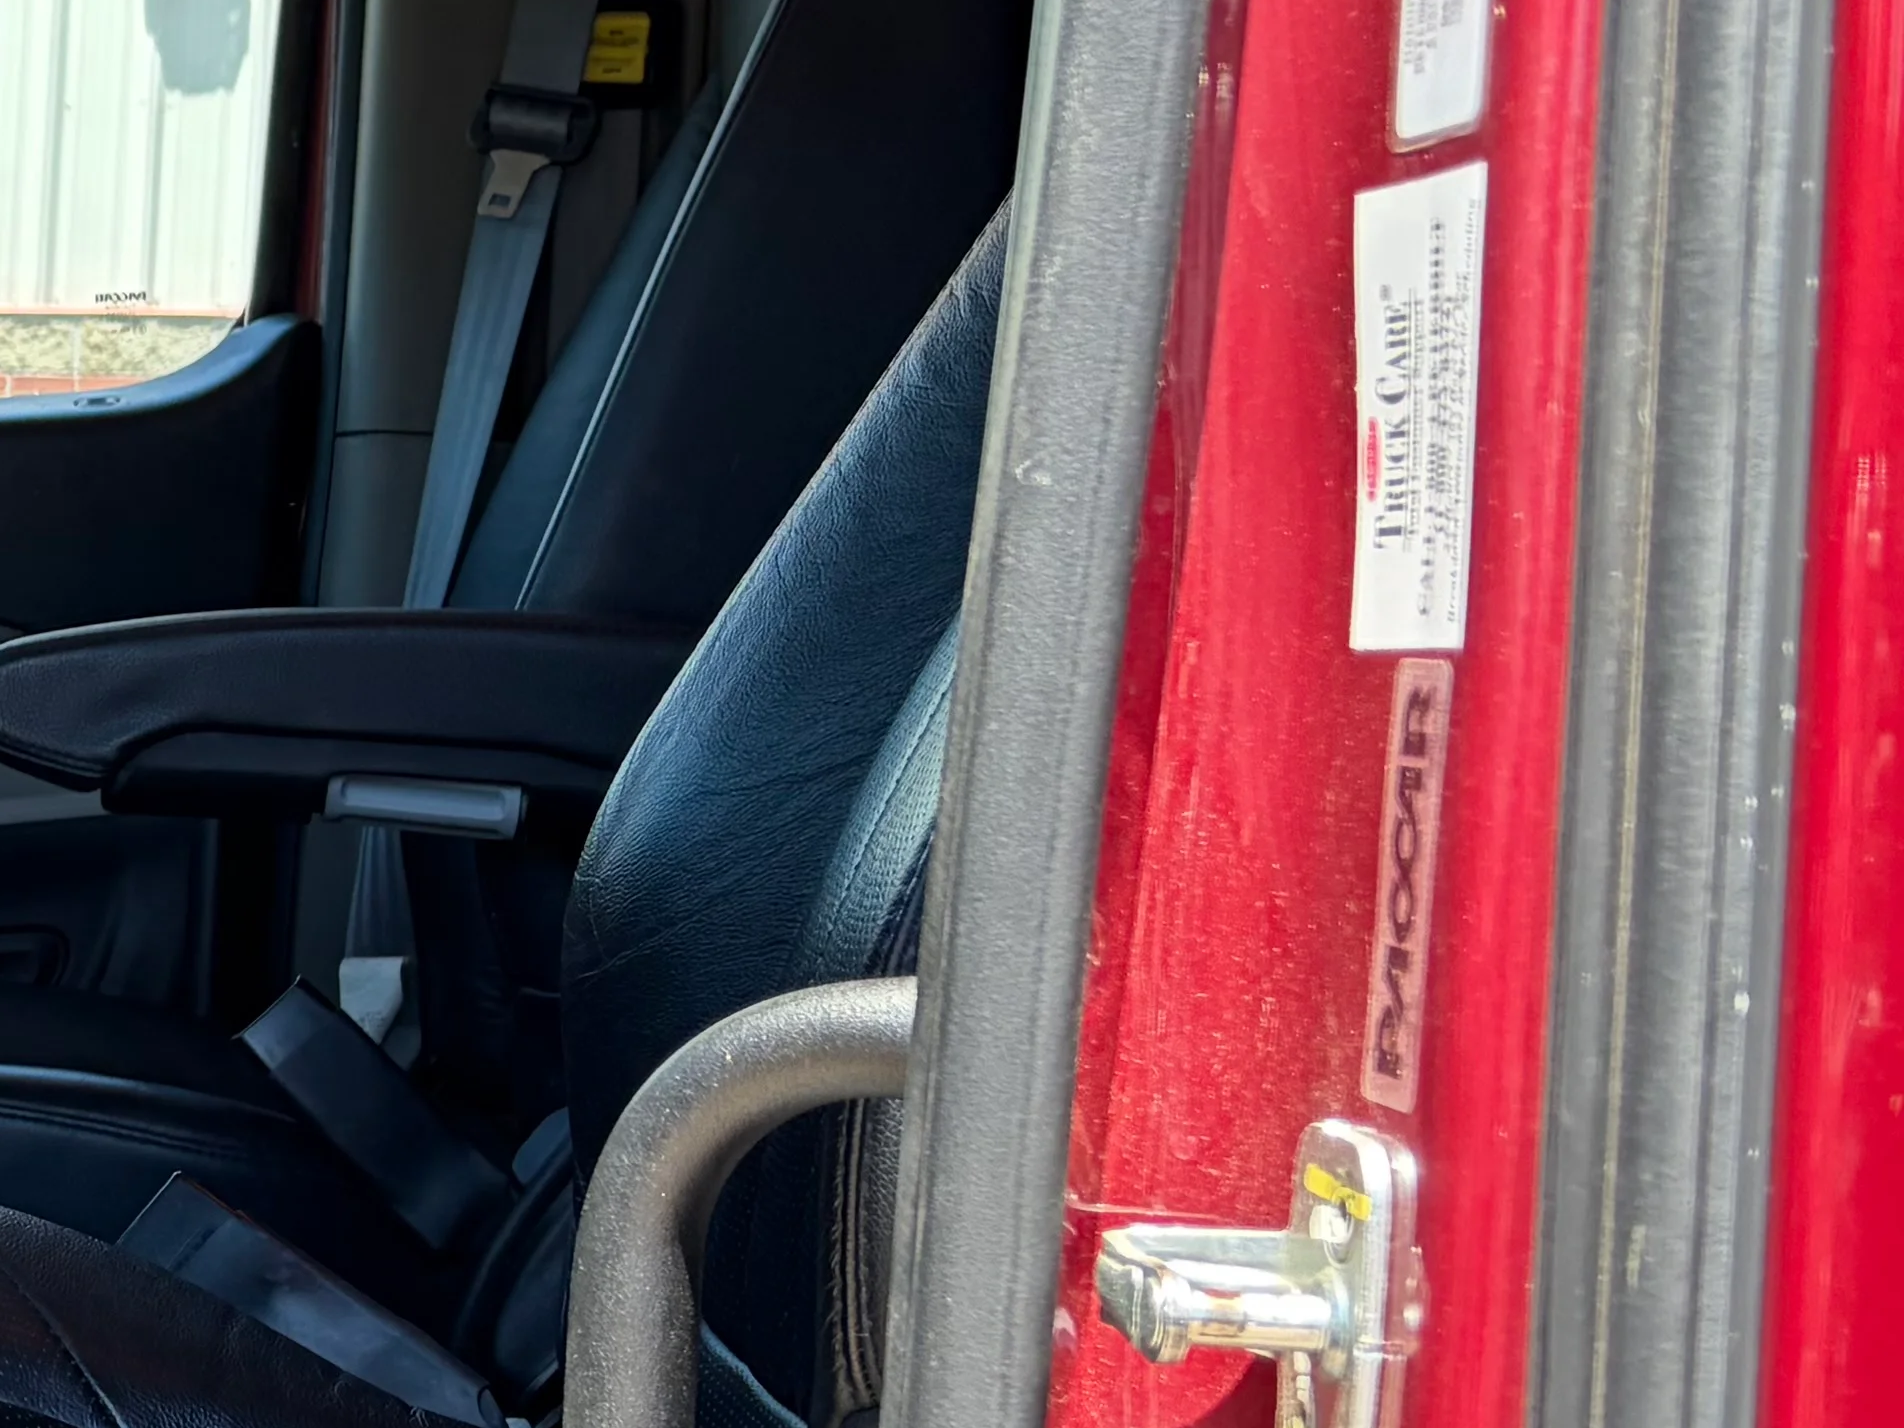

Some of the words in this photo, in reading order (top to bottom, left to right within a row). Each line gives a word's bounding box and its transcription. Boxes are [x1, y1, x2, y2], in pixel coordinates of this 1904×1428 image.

[1375, 300, 1409, 404] CARE
[1373, 418, 1407, 549] TRUCK
[1374, 684, 1437, 1080] PACCAR
